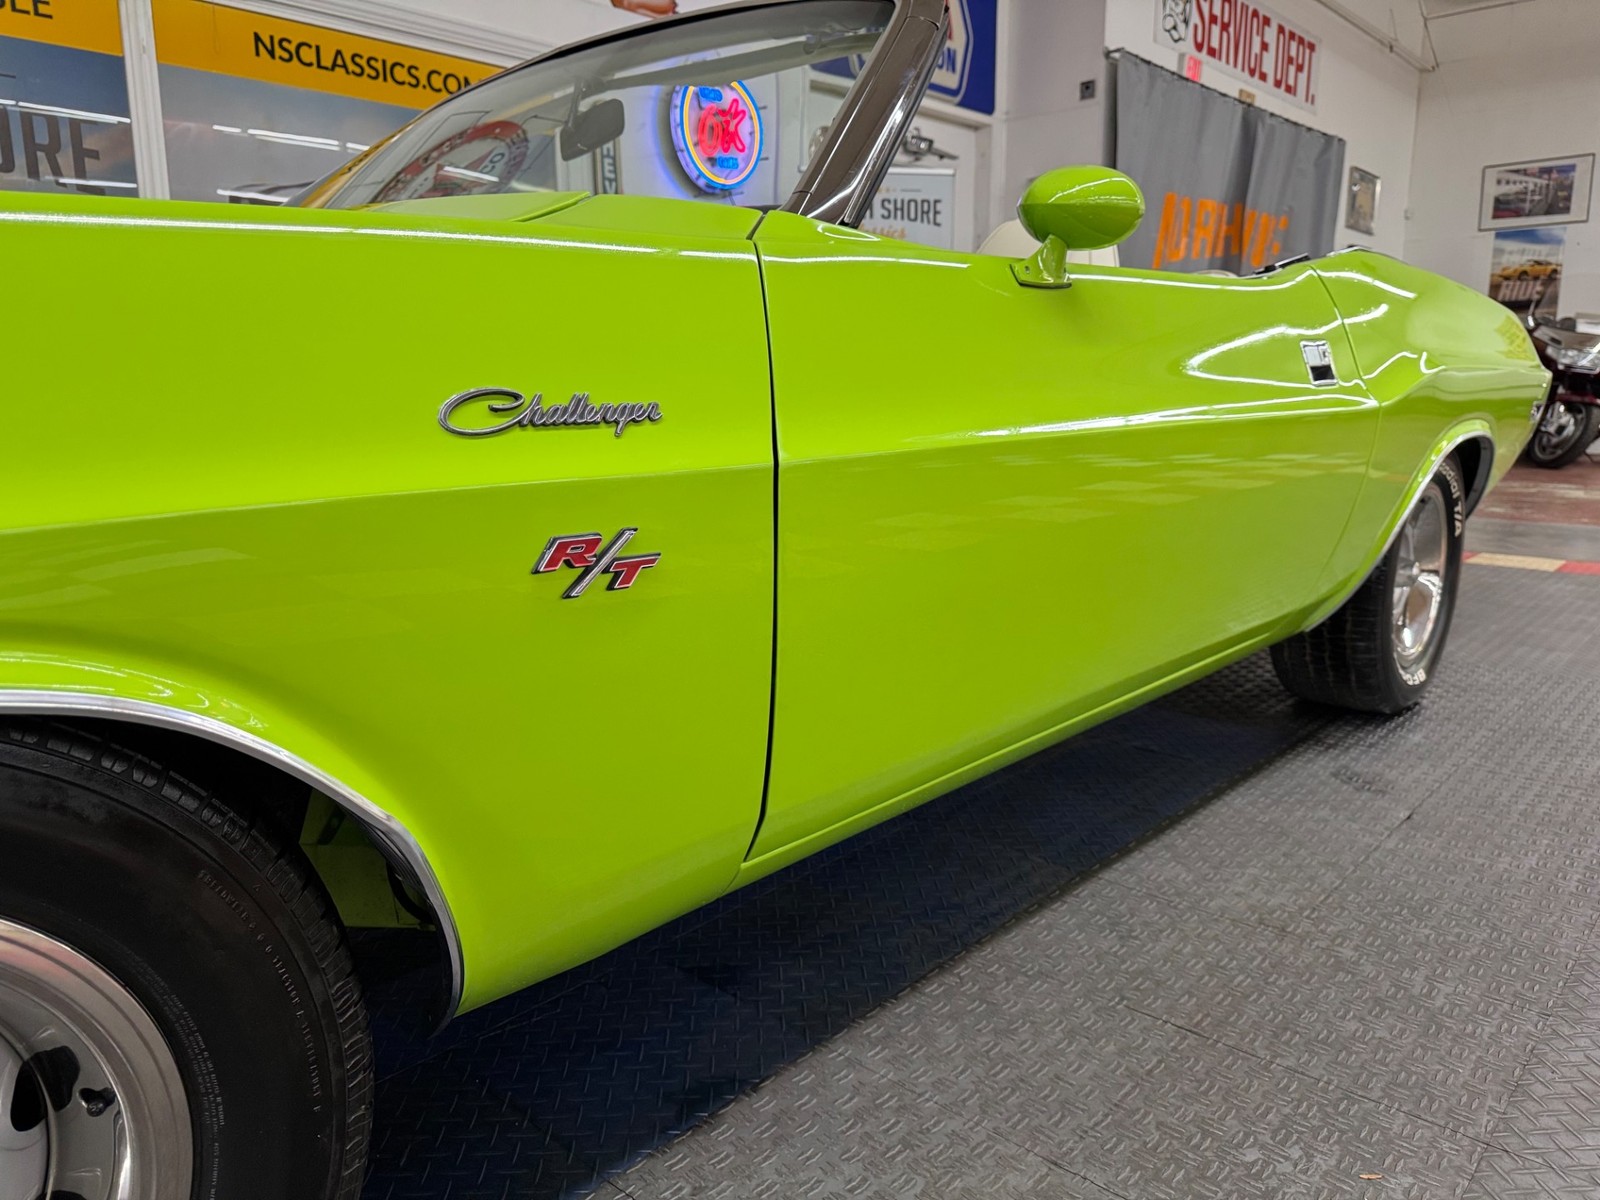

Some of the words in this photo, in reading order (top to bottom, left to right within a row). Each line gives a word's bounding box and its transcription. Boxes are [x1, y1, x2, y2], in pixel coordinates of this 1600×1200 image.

[1193, 0, 1271, 83] SERVICE
[1273, 23, 1316, 105] DEPT.
[698, 98, 746, 156] OK
[881, 198, 942, 227] SHORE
[438, 386, 663, 437] Challenger
[531, 527, 661, 599] R/T
